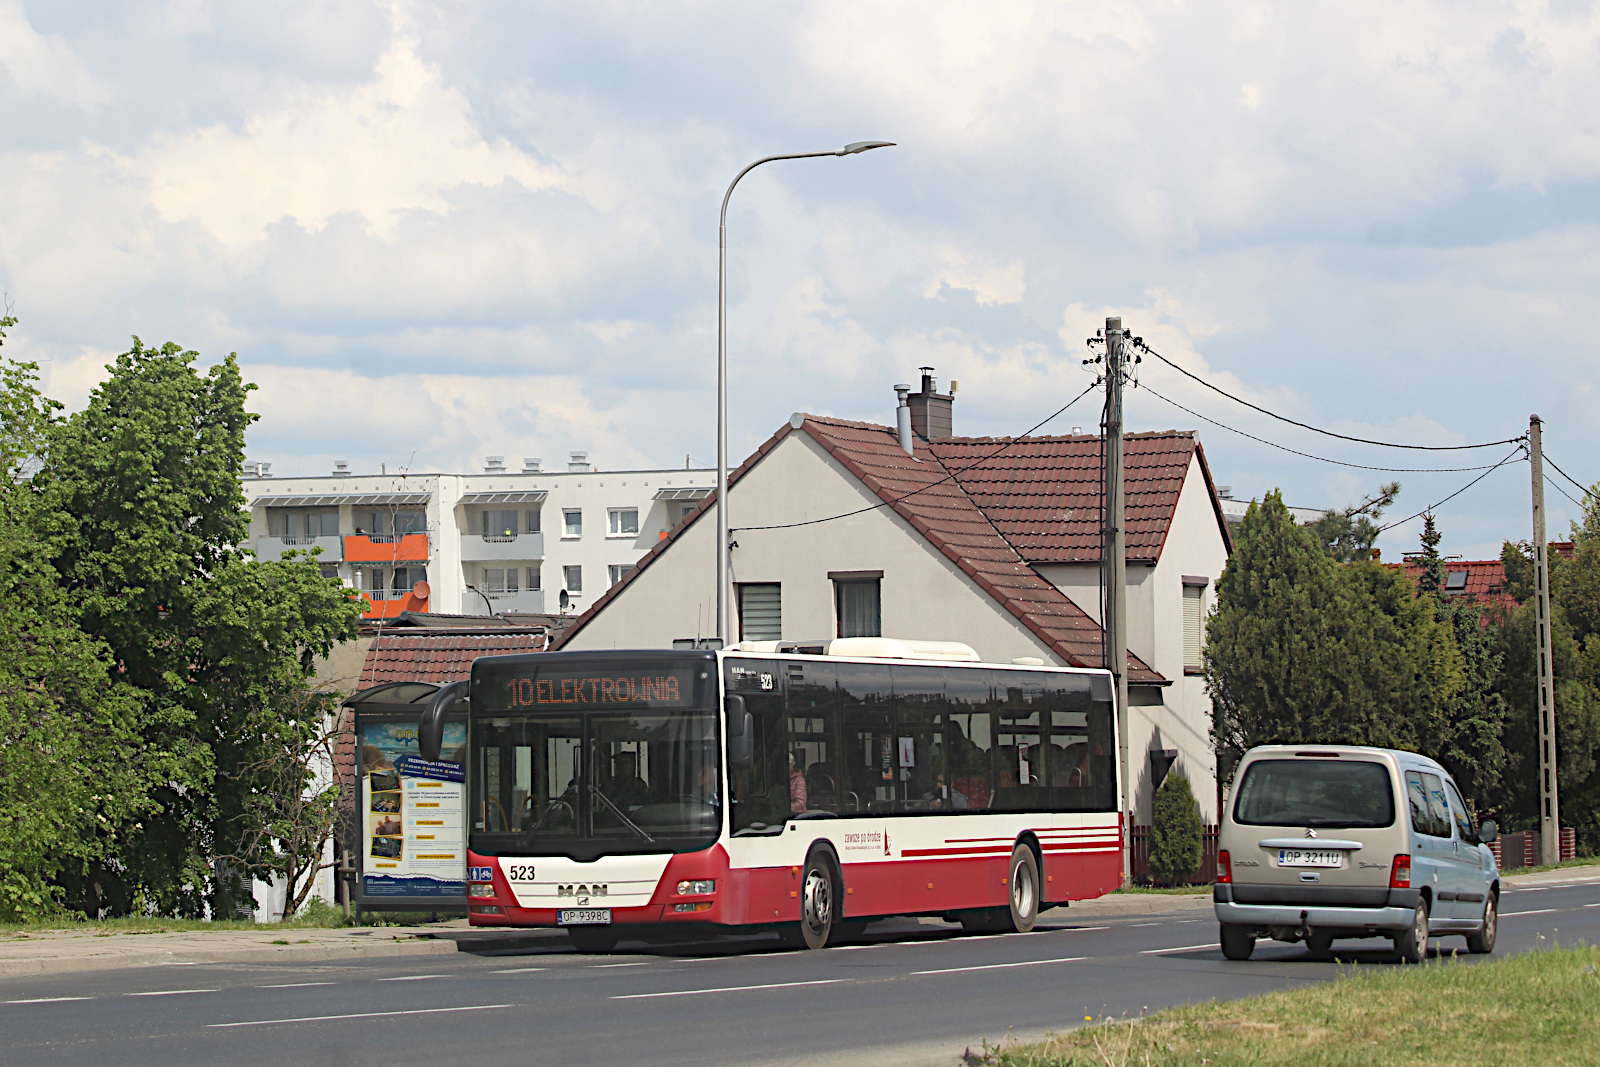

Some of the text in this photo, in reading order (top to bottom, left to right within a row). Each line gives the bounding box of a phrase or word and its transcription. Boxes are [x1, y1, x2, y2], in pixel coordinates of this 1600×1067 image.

[731, 666, 745, 674] MAN
[760, 673, 773, 690] 523
[507, 675, 681, 706] 10 ELEKTROWNIA
[1285, 851, 1340, 864] OP 3211U
[509, 865, 536, 881] 523
[557, 884, 609, 898] MAN
[563, 911, 609, 922] OP 9398C
